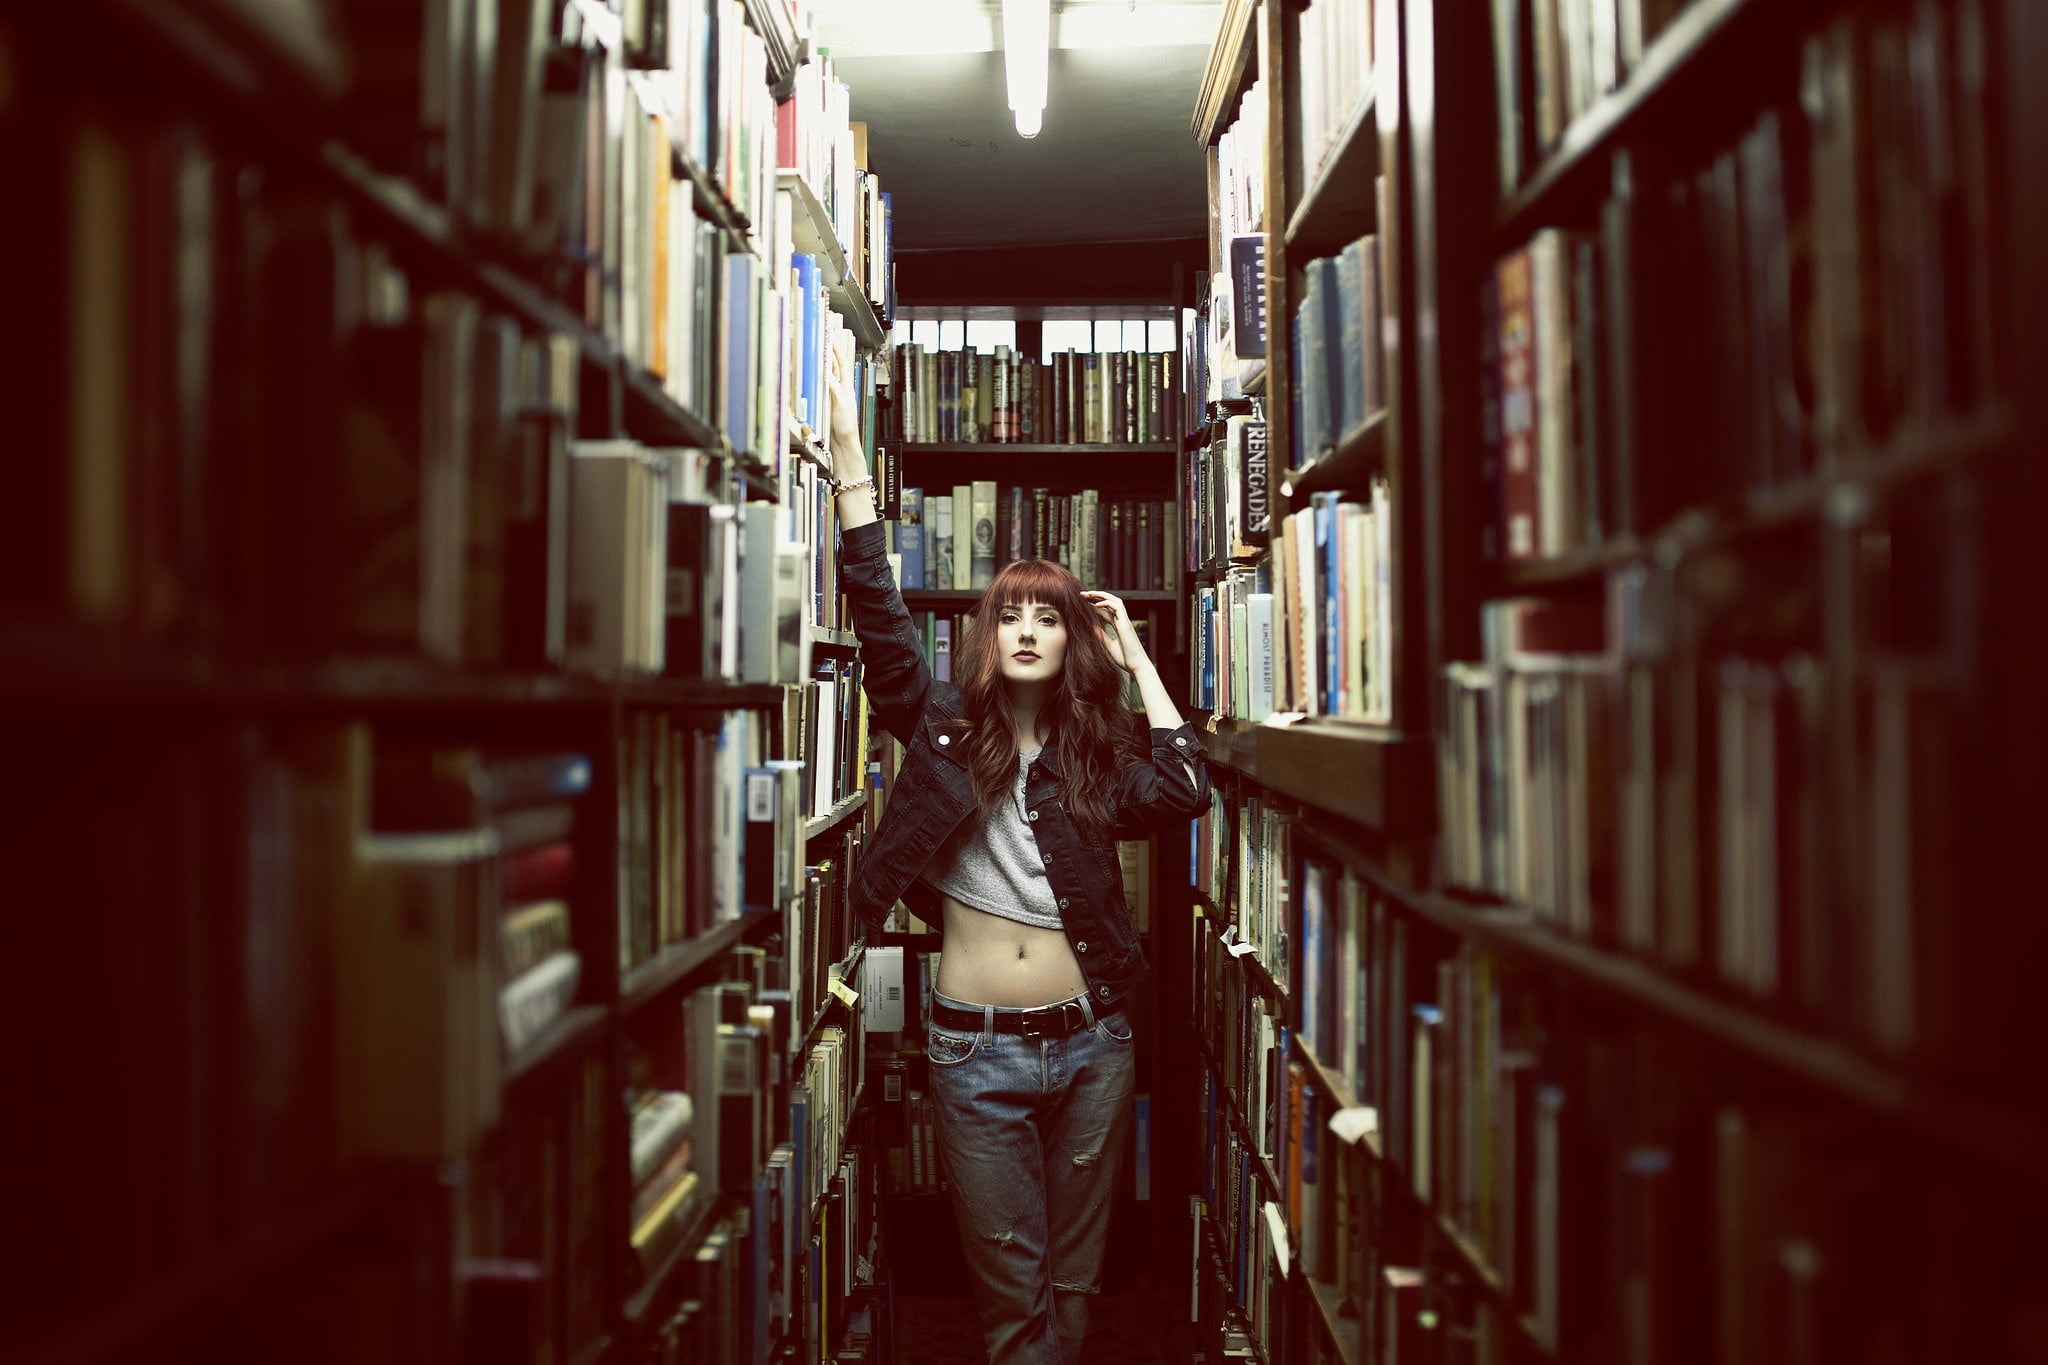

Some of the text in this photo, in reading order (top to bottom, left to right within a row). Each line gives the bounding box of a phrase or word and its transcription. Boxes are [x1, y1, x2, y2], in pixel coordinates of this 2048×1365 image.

[1246, 427, 1267, 532] RENEGADES
[1262, 623, 1272, 693] ALMOST PARADISE
